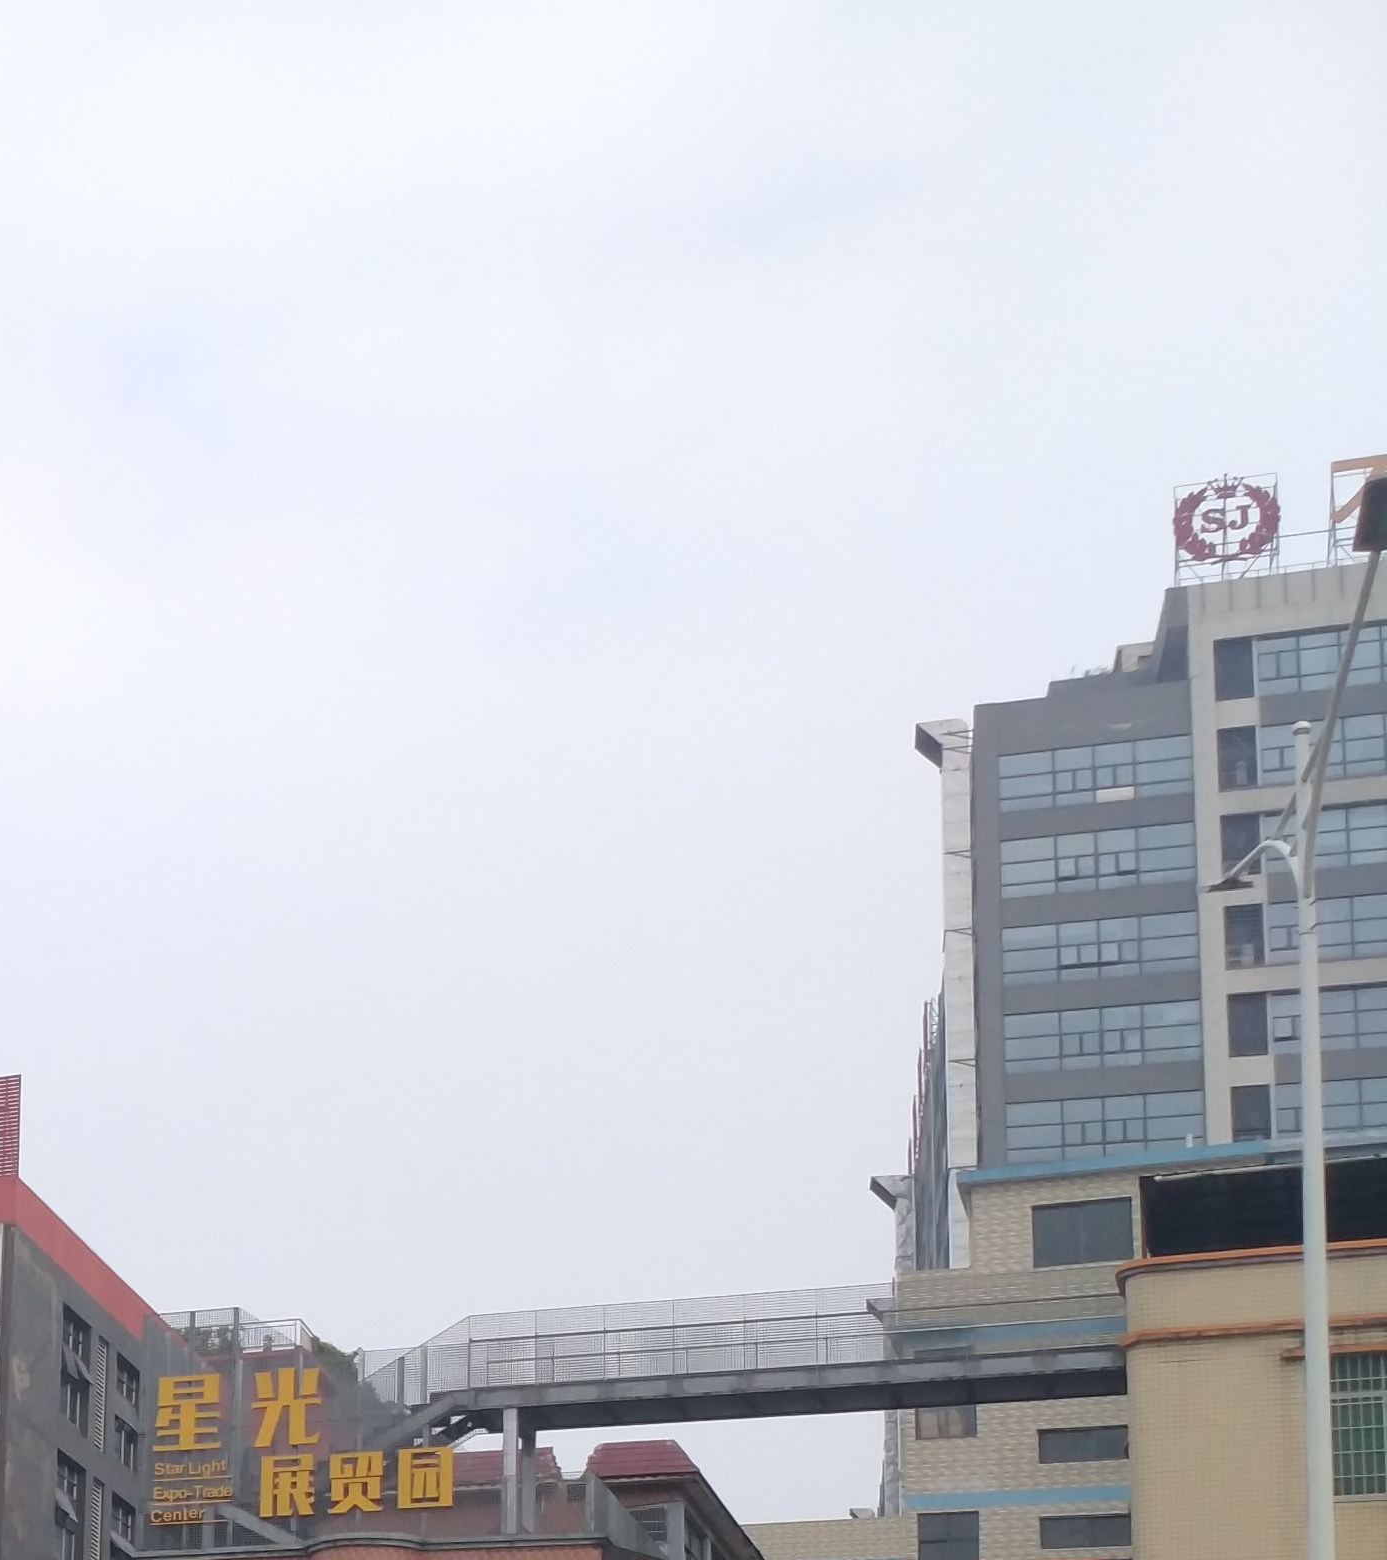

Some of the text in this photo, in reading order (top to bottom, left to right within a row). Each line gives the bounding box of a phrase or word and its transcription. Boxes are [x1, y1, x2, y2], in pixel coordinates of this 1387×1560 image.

[1200, 505, 1252, 534] SJ
[153, 1366, 323, 1452] 星光
[259, 1446, 454, 1518] 展贸园
[150, 1507, 206, 1525] Center
